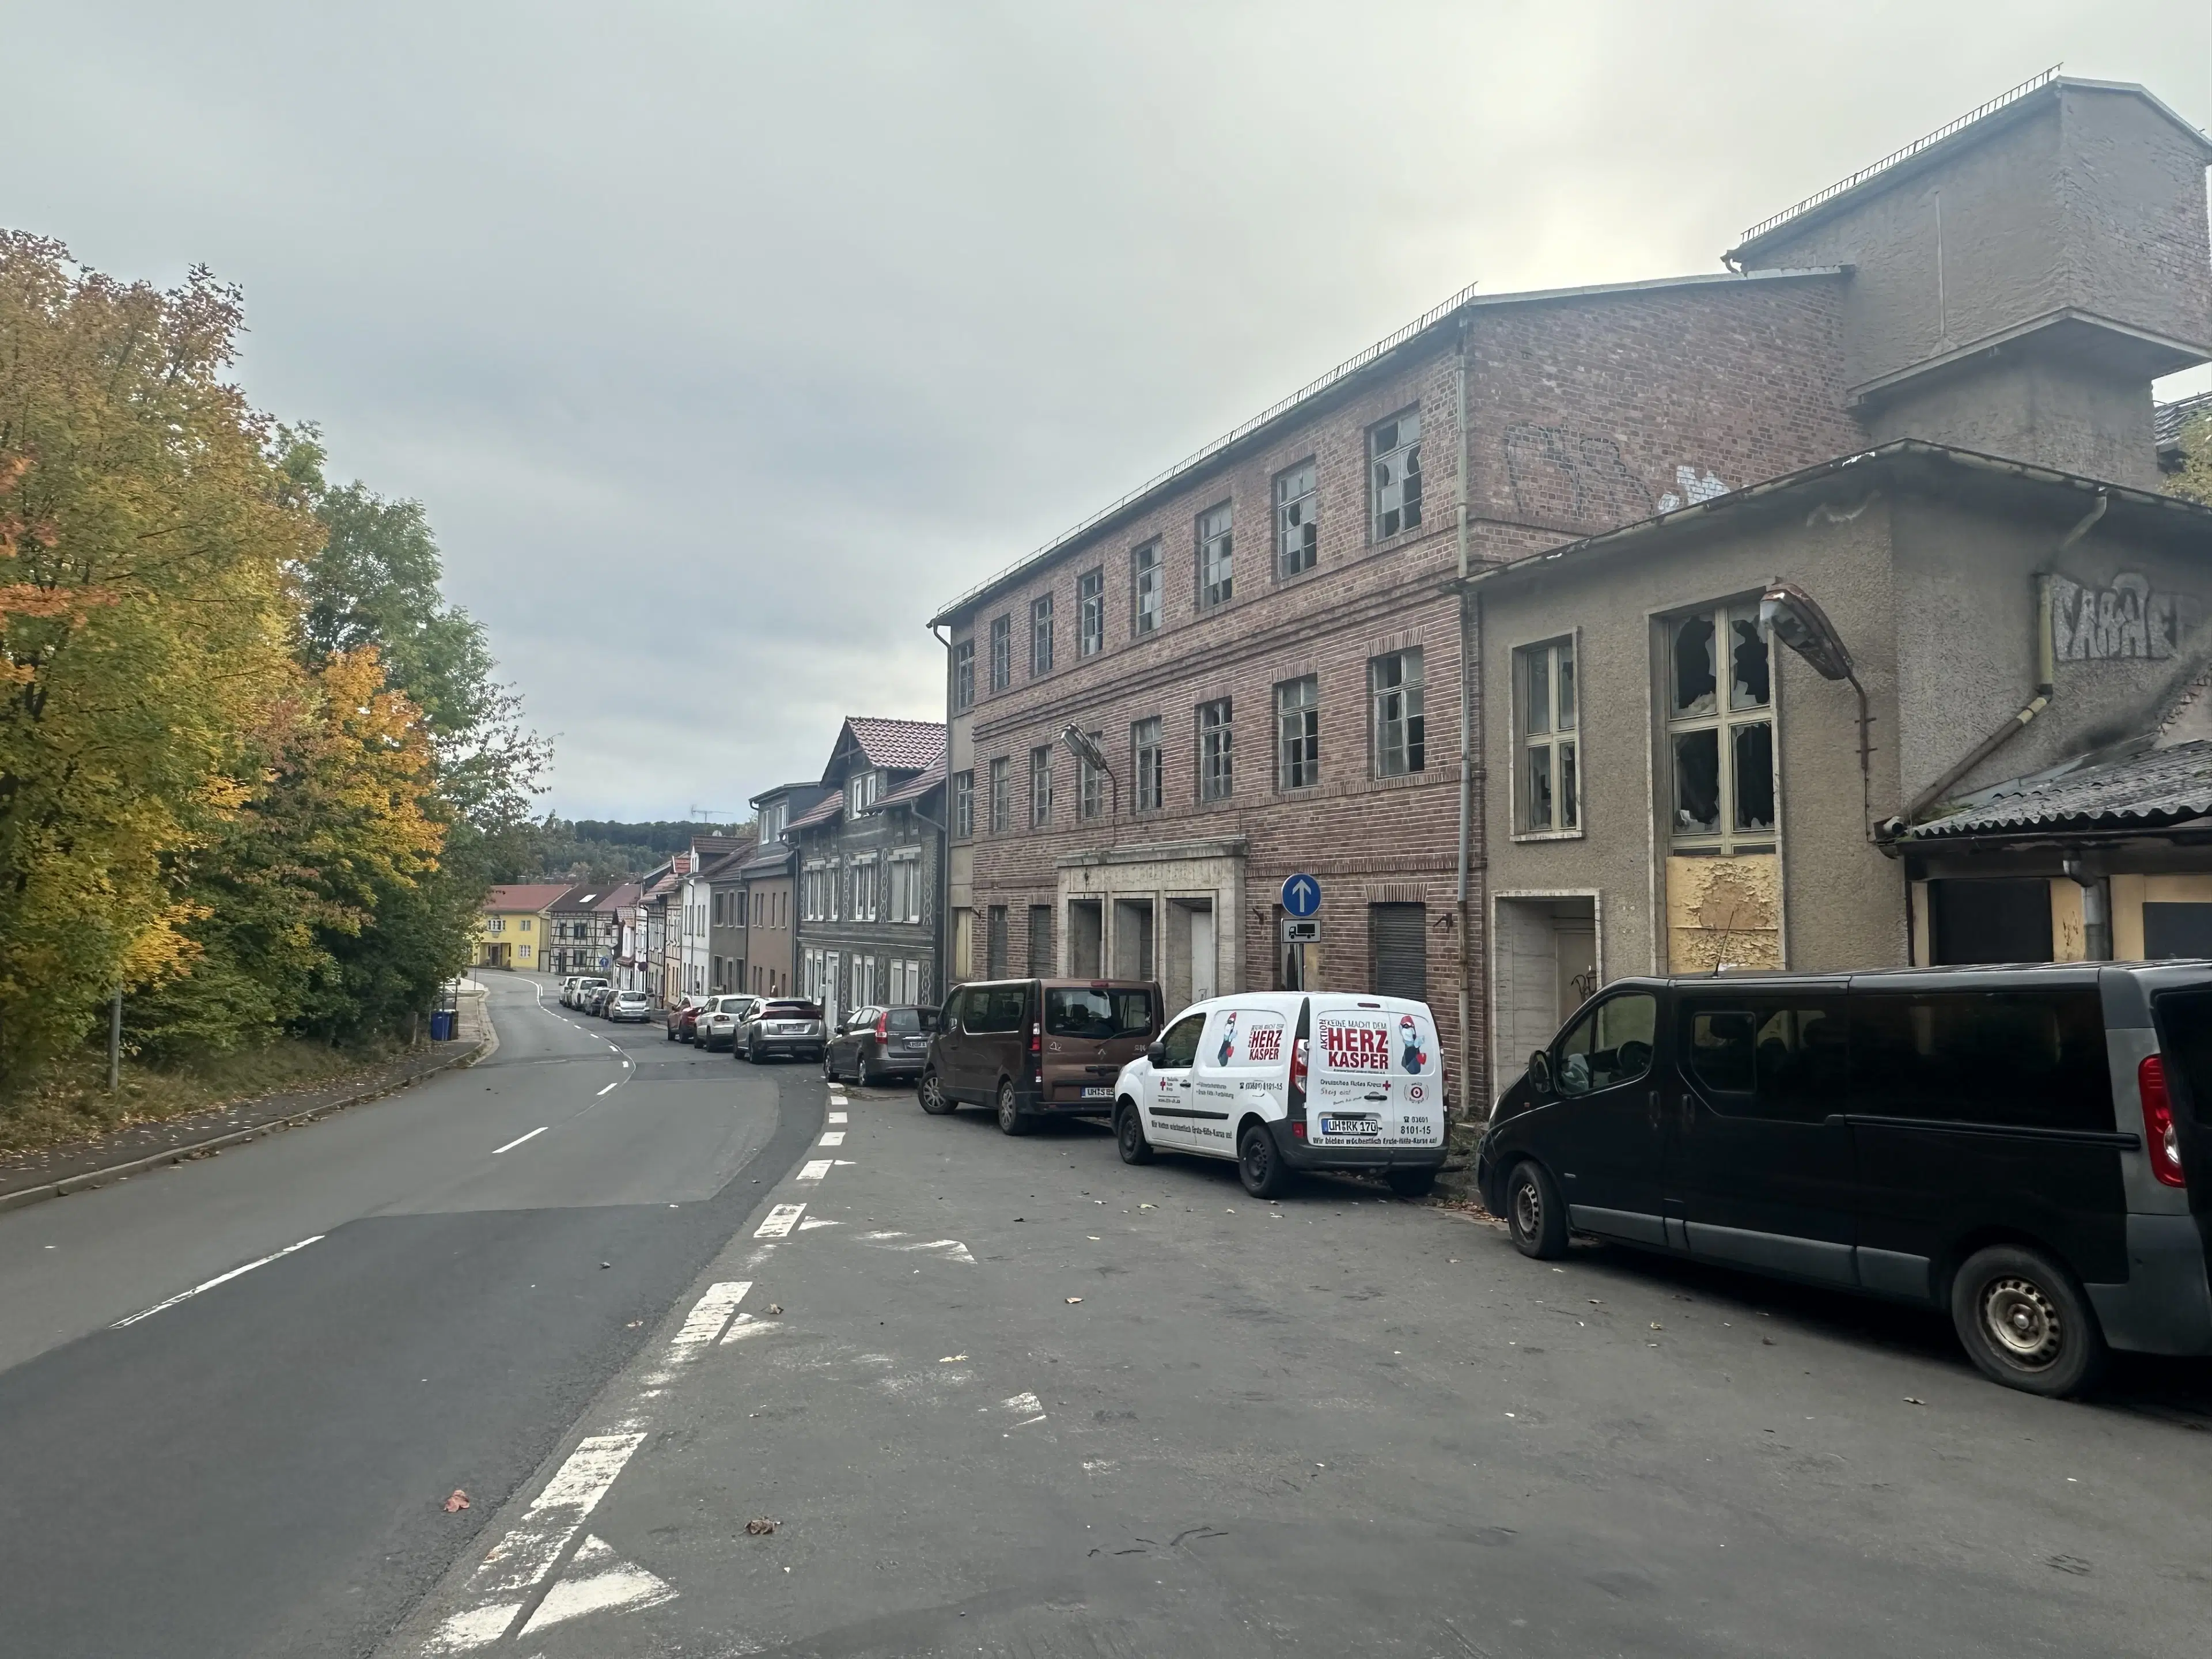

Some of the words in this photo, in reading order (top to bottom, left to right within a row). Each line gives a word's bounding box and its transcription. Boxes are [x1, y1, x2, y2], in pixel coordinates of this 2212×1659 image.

[1319, 1019, 1328, 1050] AKTION
[1249, 1048, 1279, 1060] KASPER
[1328, 1051, 1388, 1069] KASPER
[1360, 1122, 1376, 1132] 170
[1401, 1126, 1431, 1134] 8101-15
